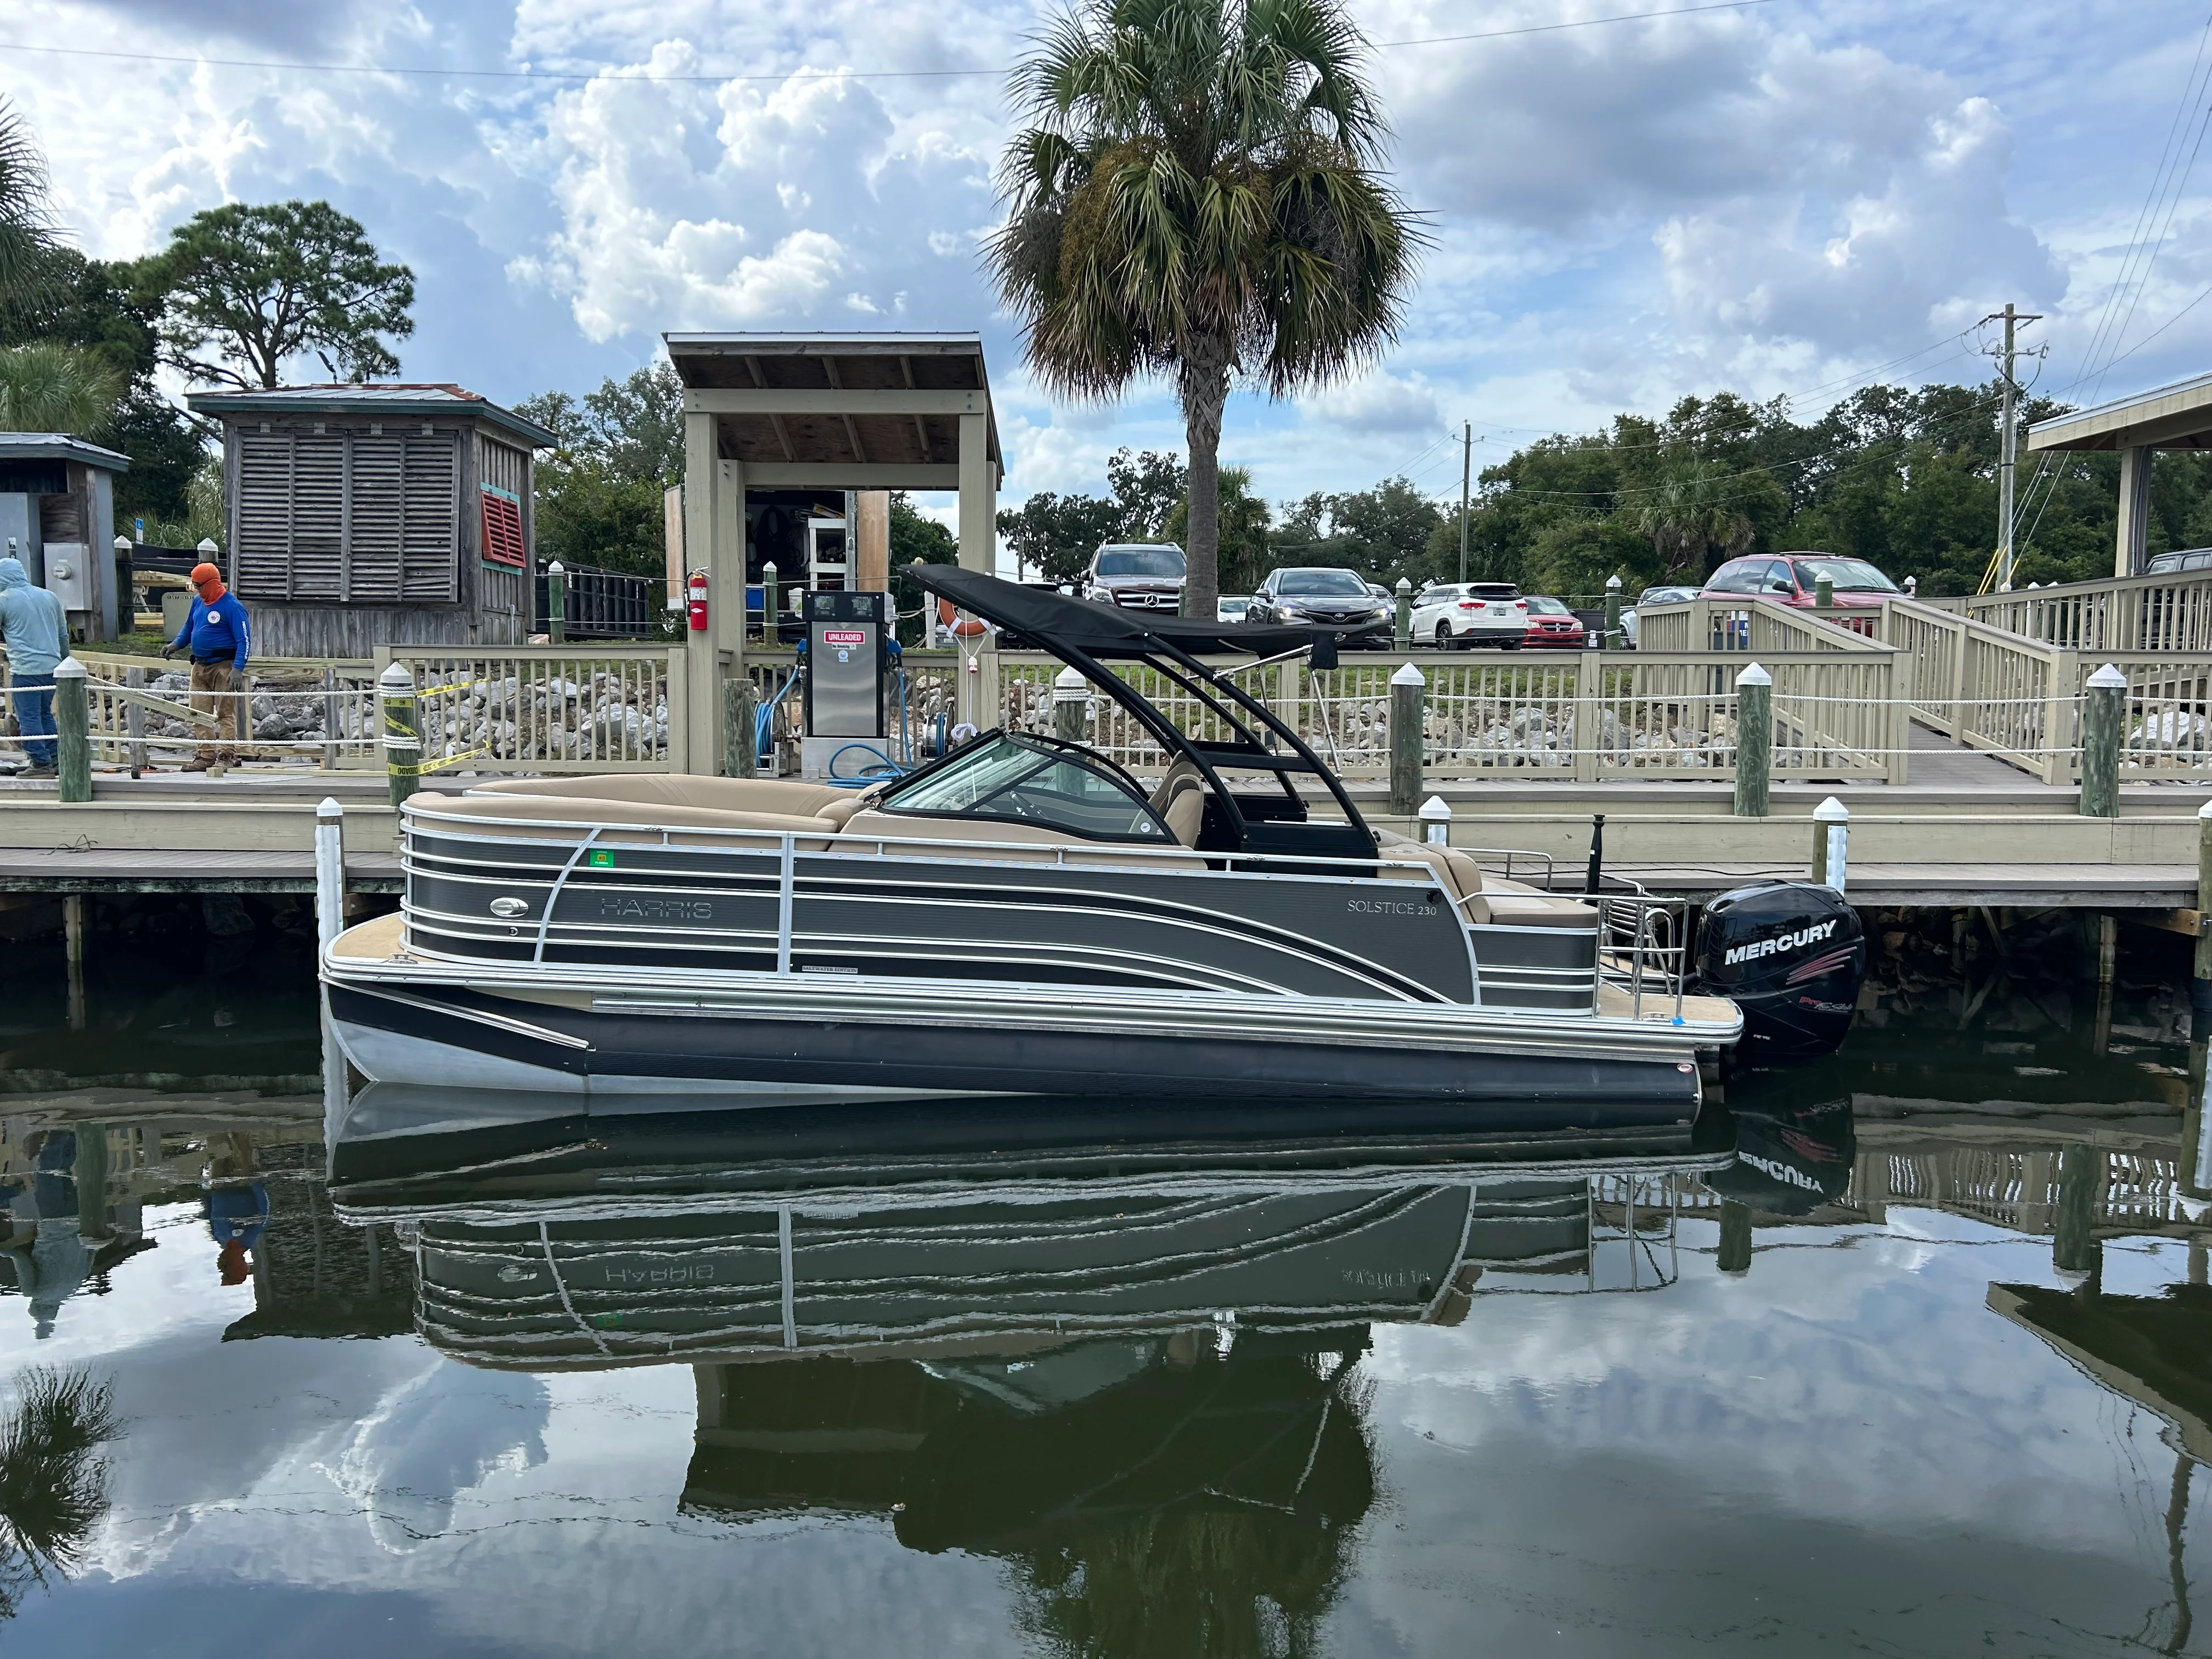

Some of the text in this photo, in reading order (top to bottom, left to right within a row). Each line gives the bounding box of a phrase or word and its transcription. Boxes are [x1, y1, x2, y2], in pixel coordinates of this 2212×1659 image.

[828, 633, 862, 641] UNLEADED
[397, 766, 418, 775] CUIDADO
[601, 898, 712, 919] HARRIS
[1347, 900, 1437, 915] SOLSTICE 230
[1725, 919, 1837, 966] MERCURY
